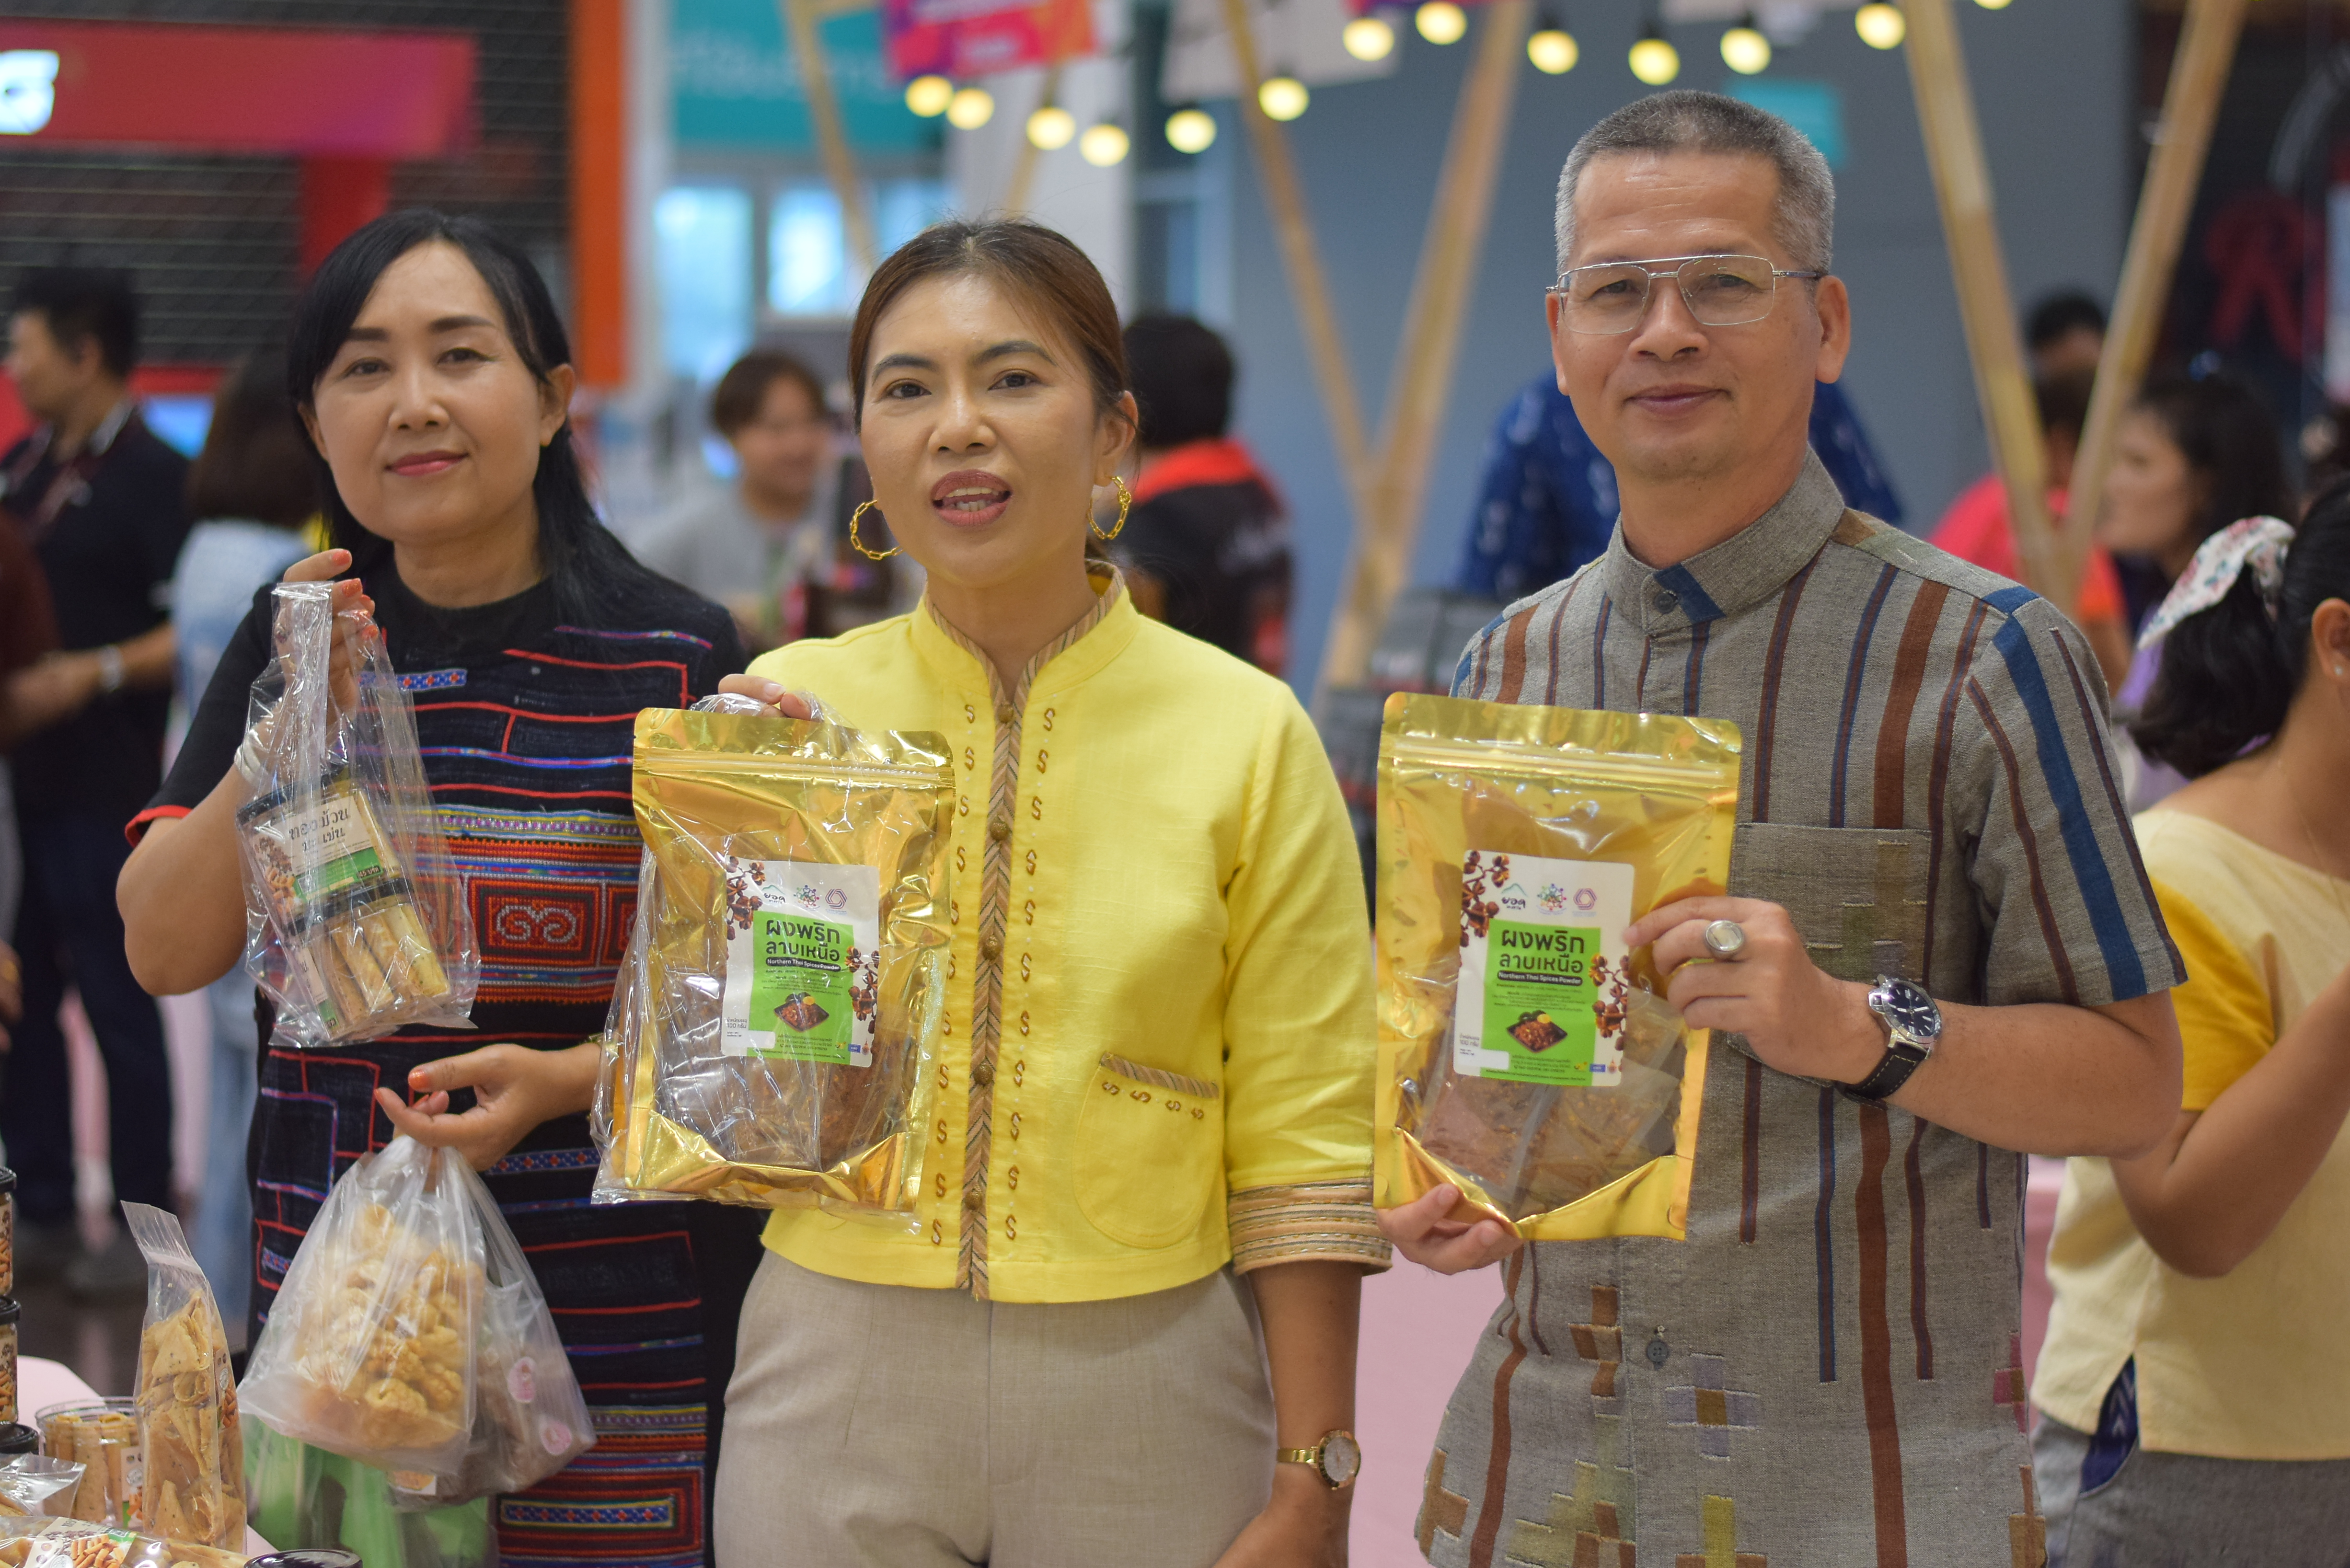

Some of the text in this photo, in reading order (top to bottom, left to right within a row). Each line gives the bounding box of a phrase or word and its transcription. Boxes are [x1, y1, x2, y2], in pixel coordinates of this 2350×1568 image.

[766, 919, 840, 944] ผงพริก
[1502, 929, 1584, 953] ผงพริก
[766, 941, 840, 961] ลาบเหนือ
[1499, 953, 1583, 973] ลาบเหนือ
